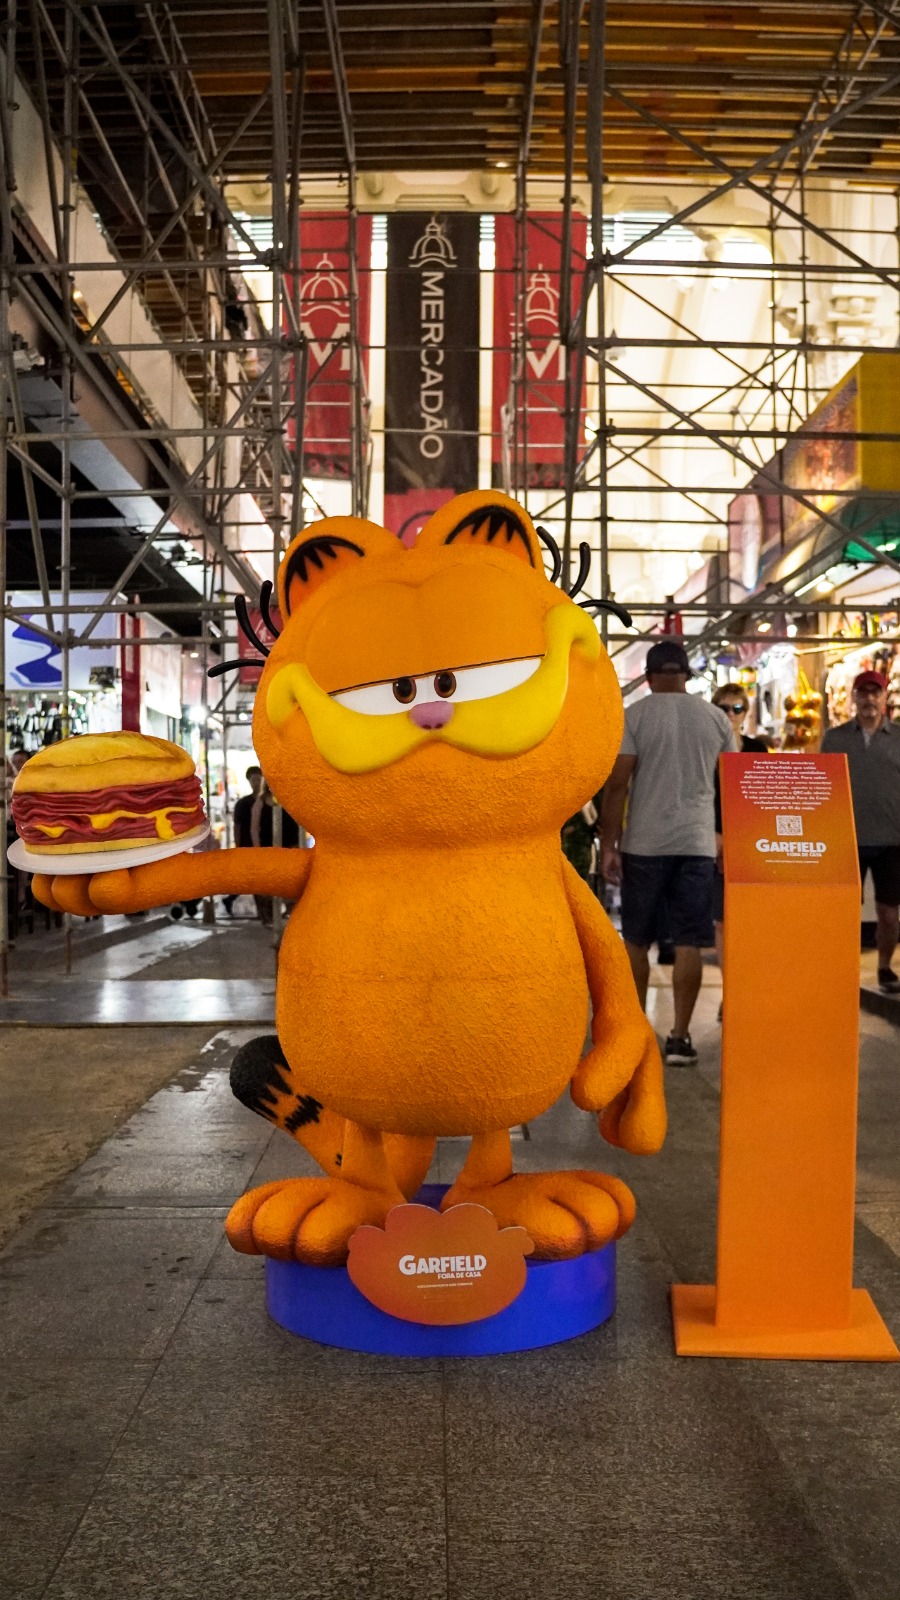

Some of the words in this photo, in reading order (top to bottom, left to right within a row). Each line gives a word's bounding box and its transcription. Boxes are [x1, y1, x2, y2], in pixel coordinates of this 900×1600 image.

[420, 271, 448, 459] MERCADÃO
[756, 839, 826, 852] GARFIELD
[399, 1255, 487, 1275] GARFIELD
